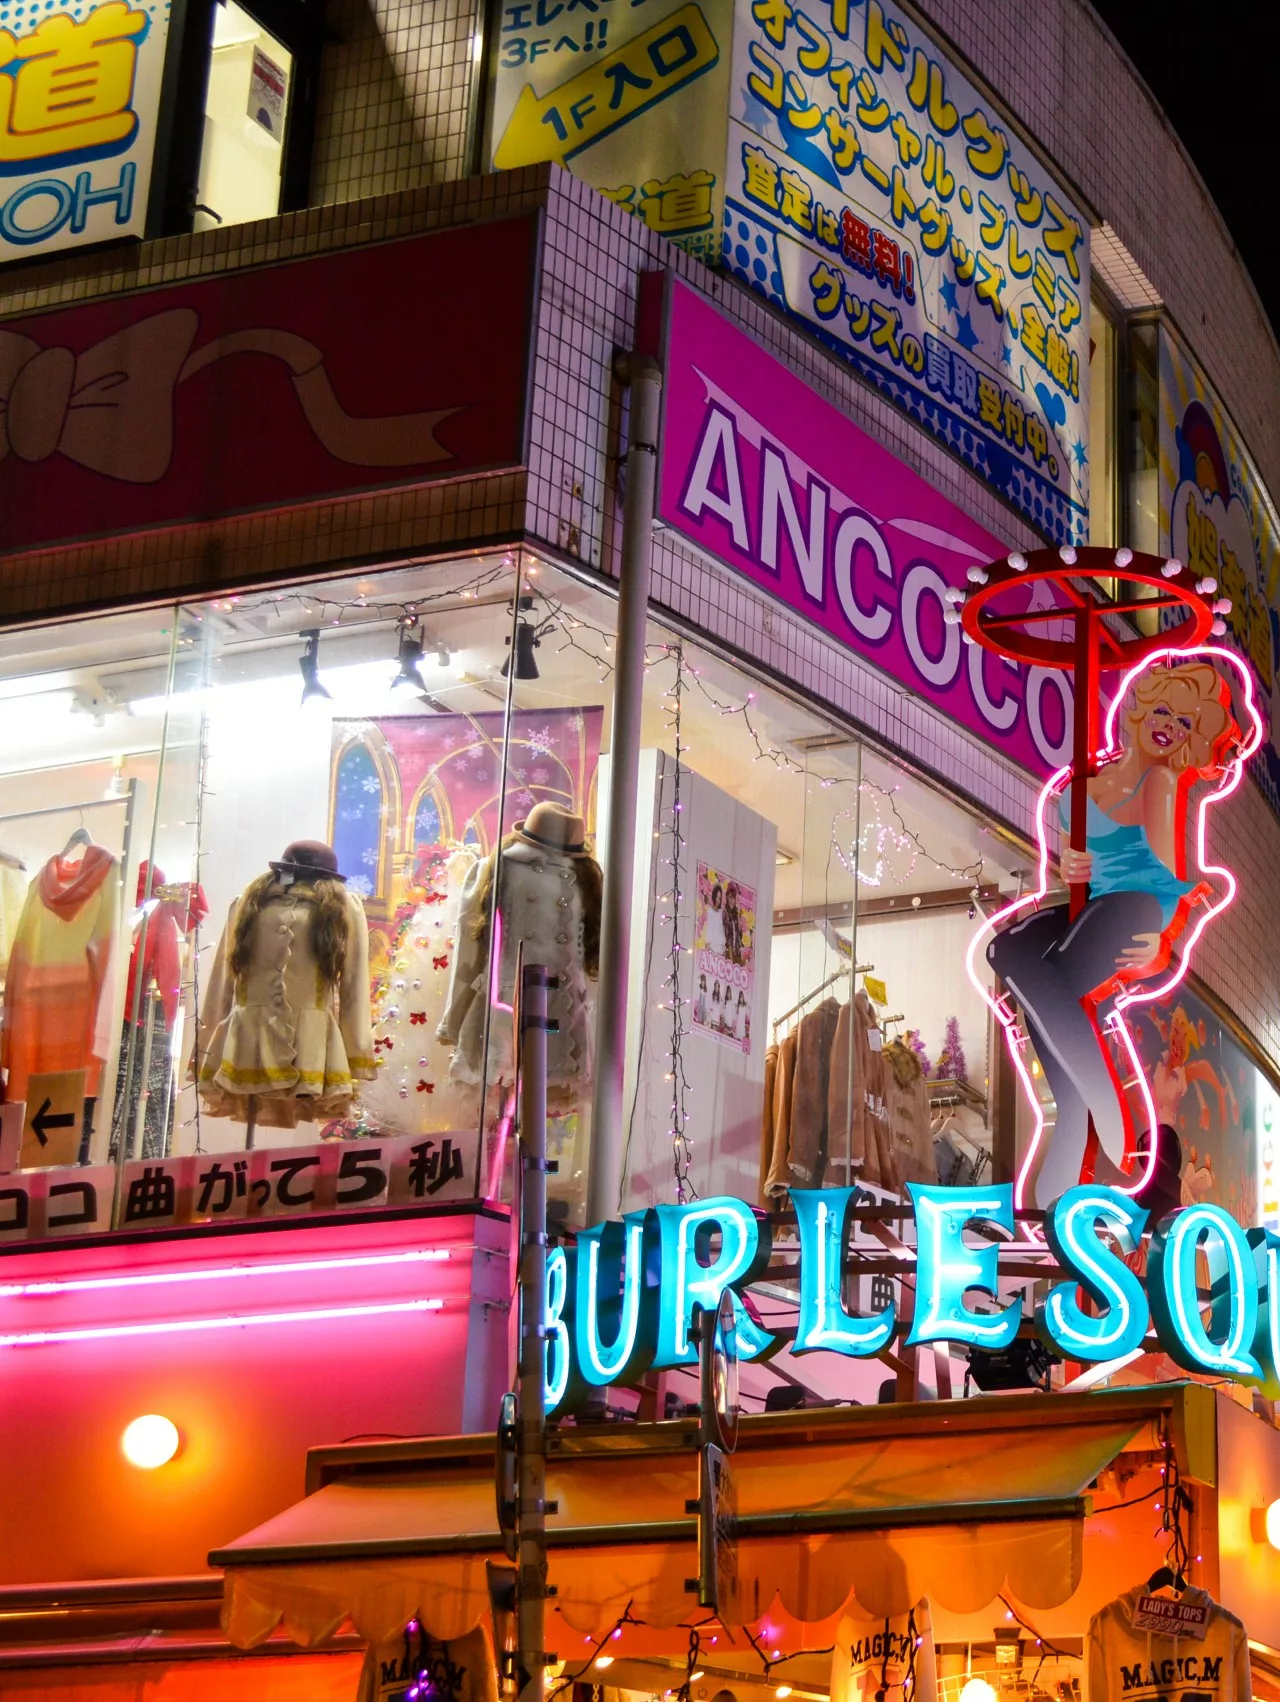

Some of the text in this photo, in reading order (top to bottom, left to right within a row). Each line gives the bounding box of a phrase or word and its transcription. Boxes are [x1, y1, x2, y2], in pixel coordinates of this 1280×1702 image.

[541, 24, 699, 141] 1F入口
[742, 142, 916, 307] 査定は無料!
[808, 262, 1060, 481] グッズの買取受付中。
[681, 405, 1080, 770] ANCOCO
[699, 952, 750, 991] ANCOCO
[1135, 1612, 1184, 1635] 2990
[1142, 1598, 1203, 1622] LADY'S TOPS
[1119, 1656, 1223, 1691] MAGIC,M
